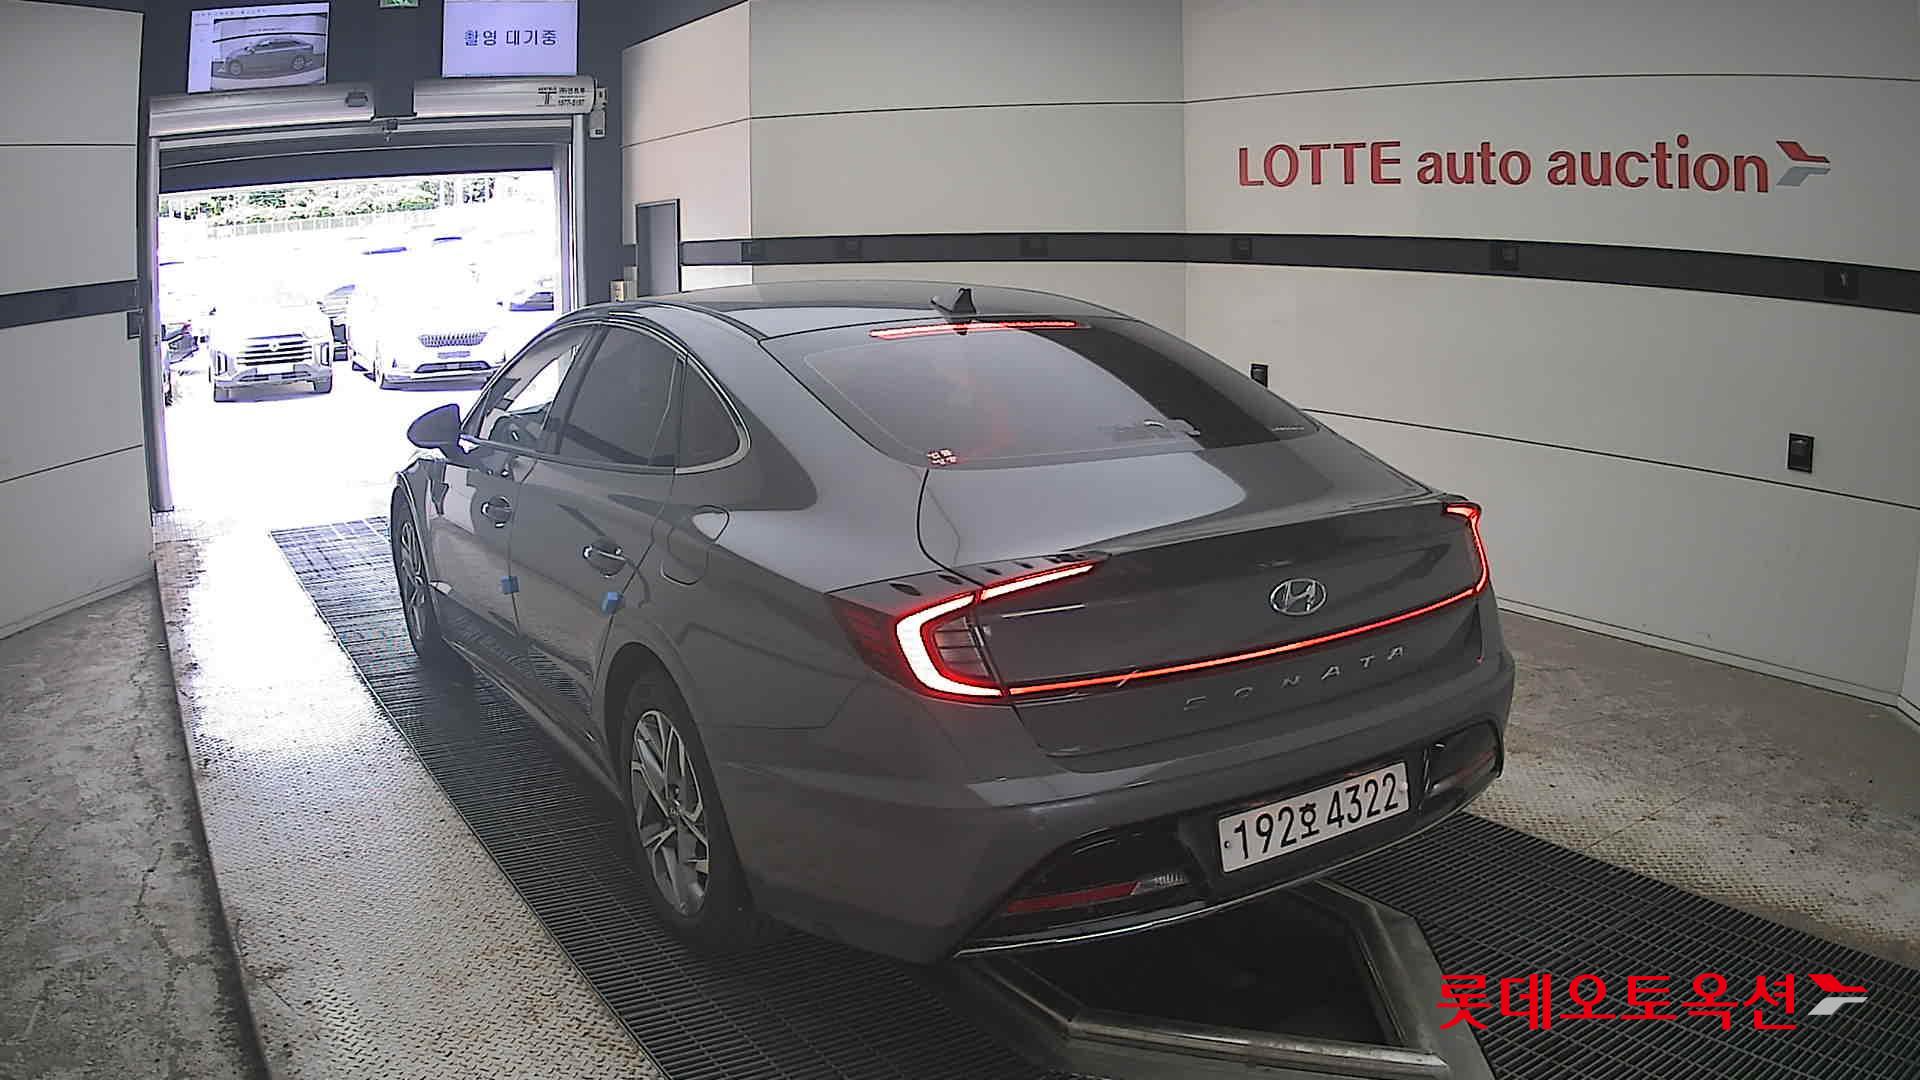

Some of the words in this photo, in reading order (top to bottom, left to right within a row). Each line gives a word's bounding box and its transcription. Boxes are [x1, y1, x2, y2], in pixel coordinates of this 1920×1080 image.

[506, 30, 556, 46] 대기중
[1238, 141, 1401, 187] LOTTE
[1416, 142, 1532, 185] auto
[1547, 133, 1769, 193] auction
[1183, 646, 1404, 711] SONATA
[1233, 802, 1320, 859] 192호
[1326, 772, 1399, 828] 4322
